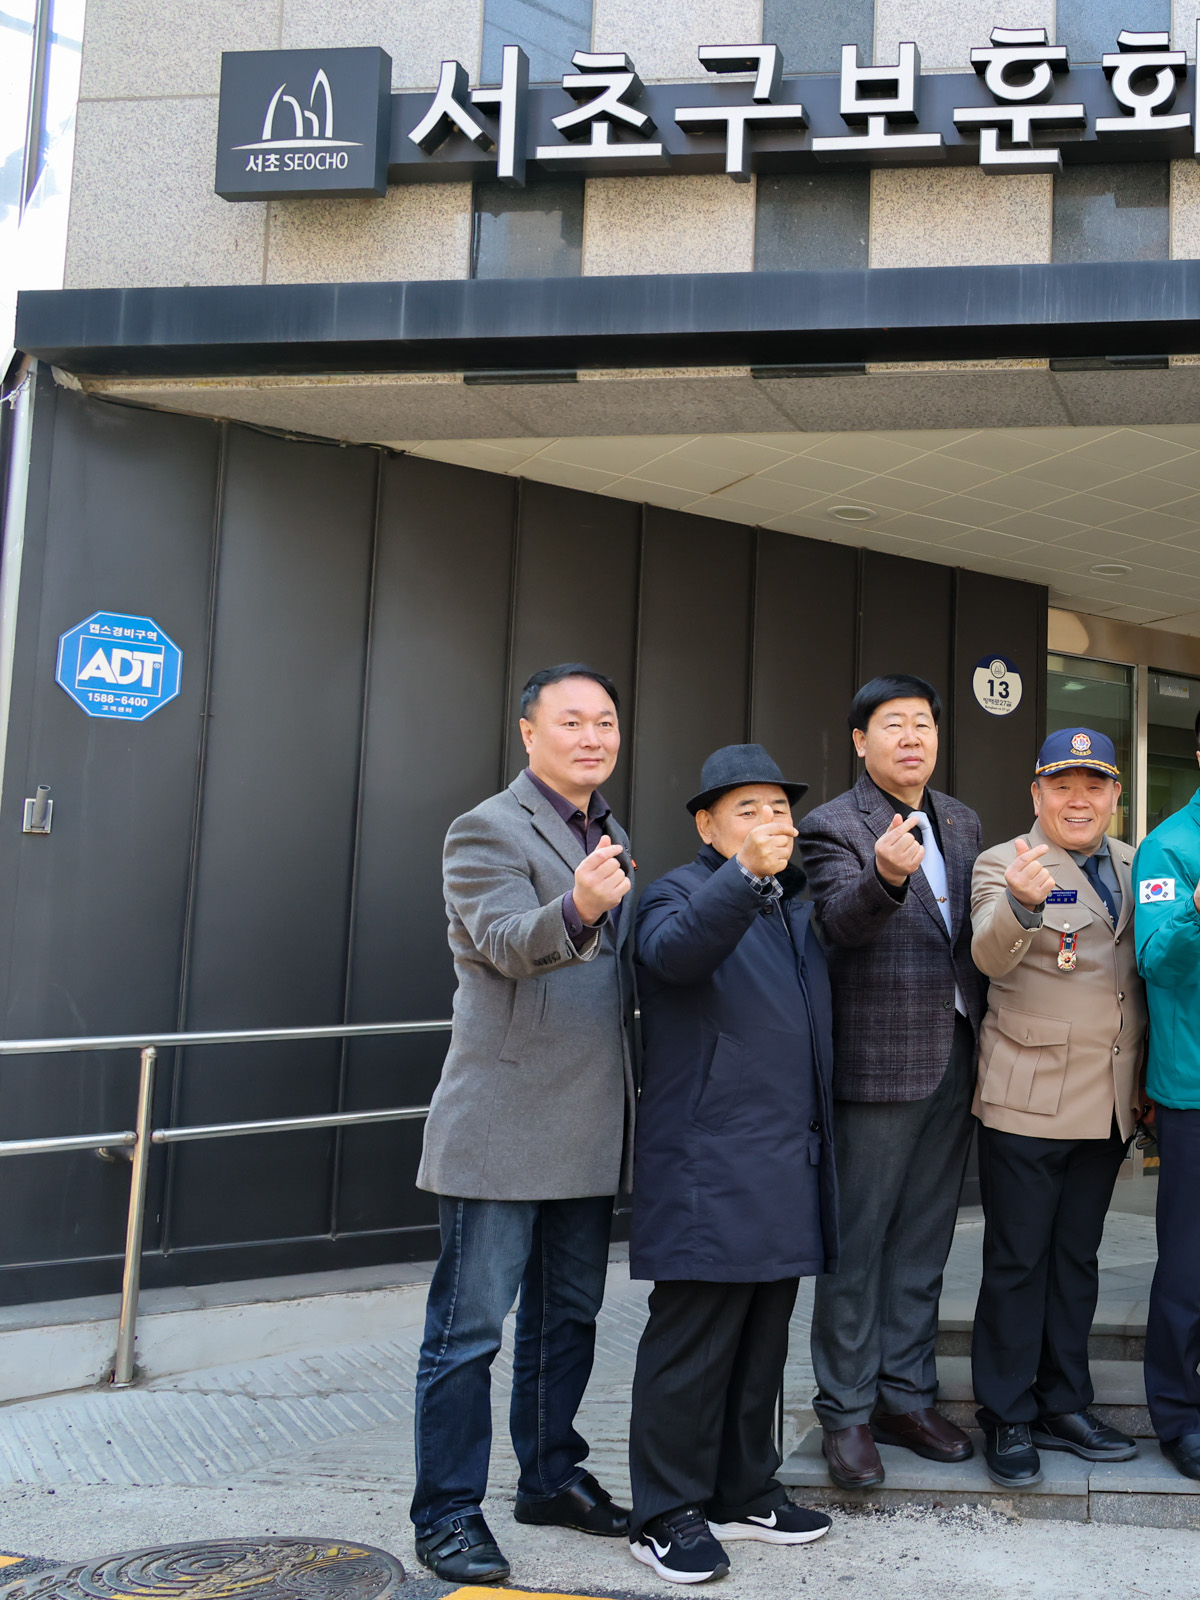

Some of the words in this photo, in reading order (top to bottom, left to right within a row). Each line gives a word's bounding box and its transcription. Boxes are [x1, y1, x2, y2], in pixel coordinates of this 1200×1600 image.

[245, 153, 280, 172] 서초
[283, 152, 349, 171] SEOCHO
[89, 623, 158, 642] 캡스경비구역
[77, 647, 164, 688] ADT
[988, 679, 1009, 698] 13
[87, 692, 148, 707] 1588-6400
[102, 705, 133, 713] 고객센터
